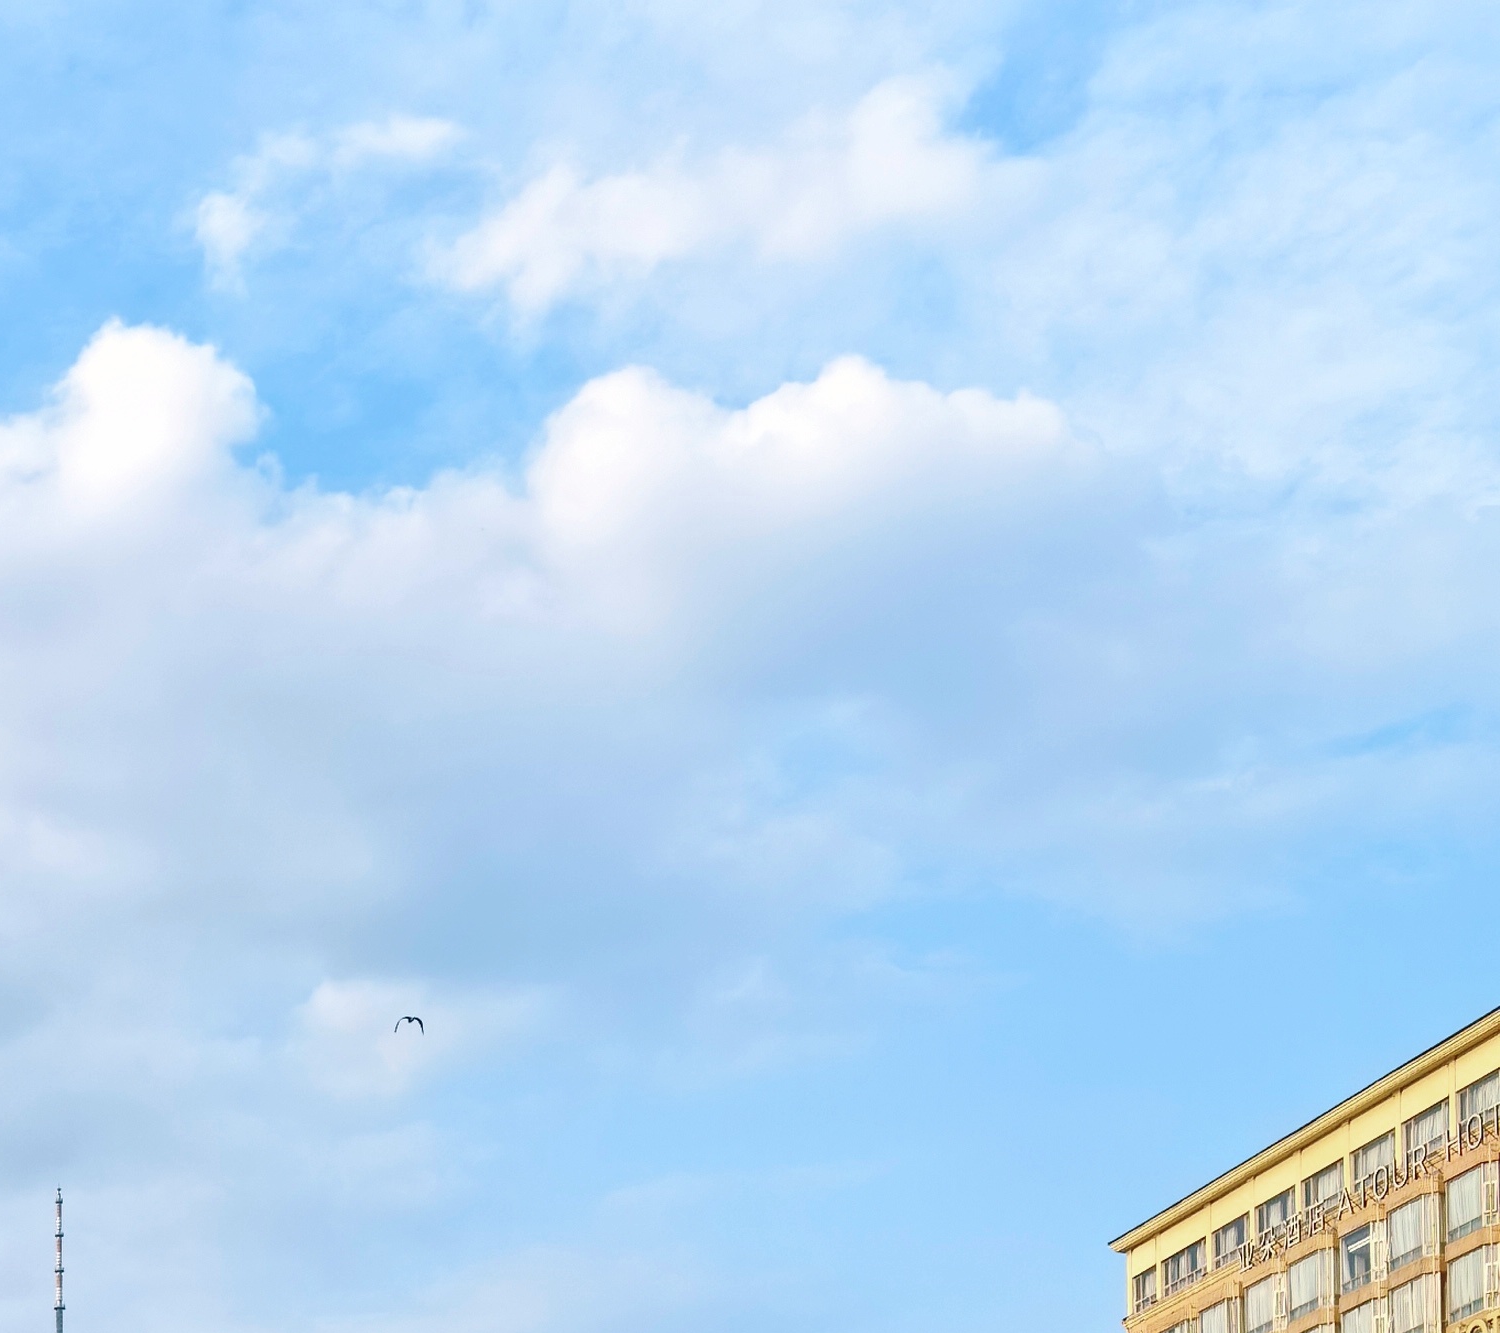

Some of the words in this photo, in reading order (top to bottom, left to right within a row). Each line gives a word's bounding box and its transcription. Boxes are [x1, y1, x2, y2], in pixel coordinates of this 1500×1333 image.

[1338, 1145, 1428, 1220] ATOUR
[1238, 1199, 1326, 1273] 亚朵酒店
